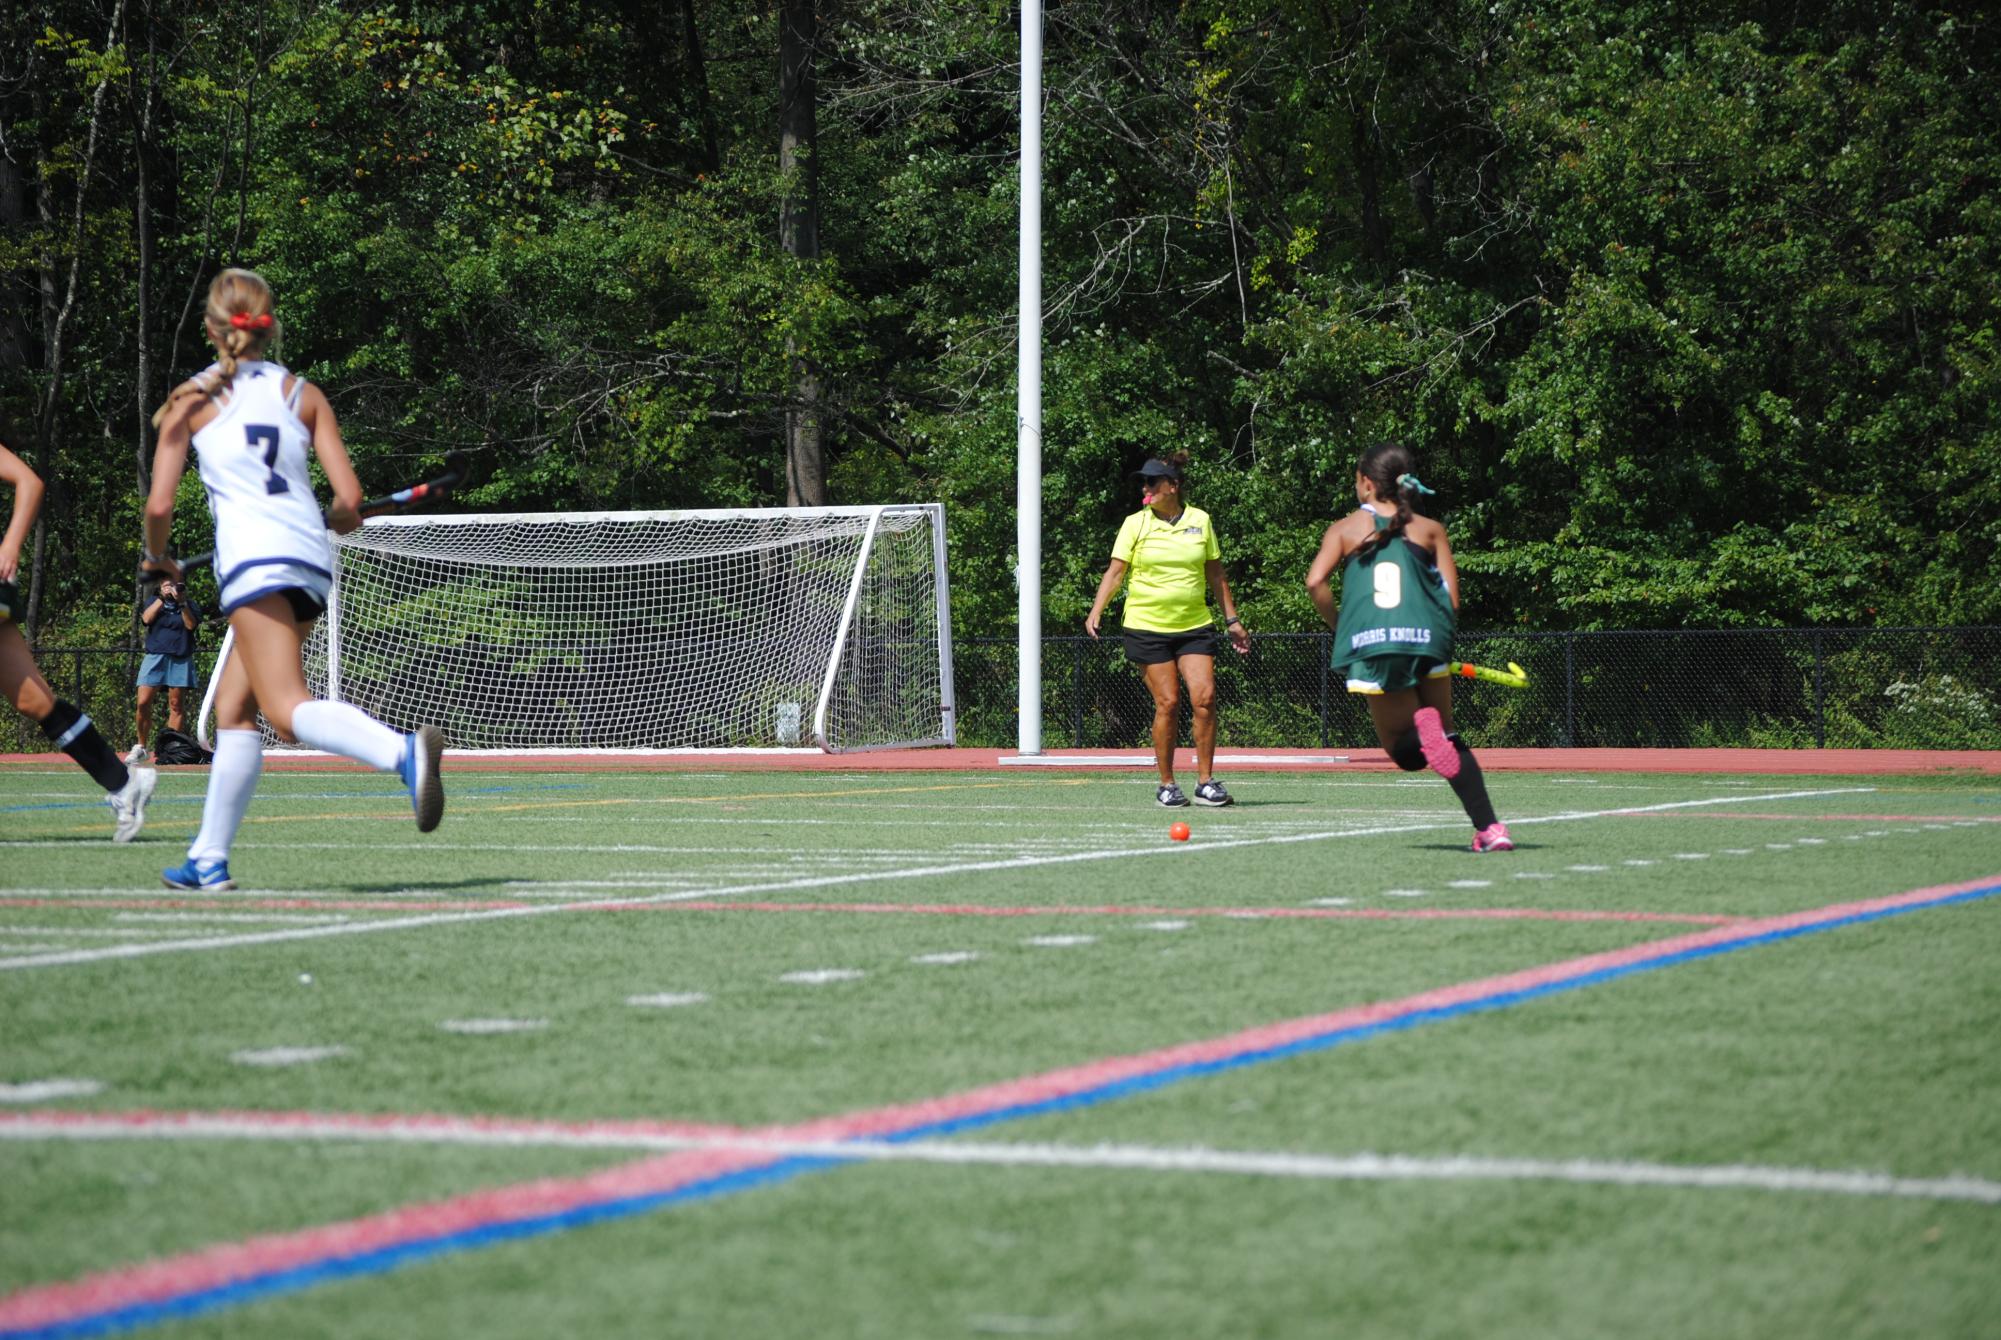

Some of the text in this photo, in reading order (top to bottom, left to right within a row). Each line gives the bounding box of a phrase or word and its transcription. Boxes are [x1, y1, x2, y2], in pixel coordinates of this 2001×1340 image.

[244, 424, 289, 495] 7
[1373, 561, 1401, 609] 9
[1389, 626, 1431, 644] KNOLLS
